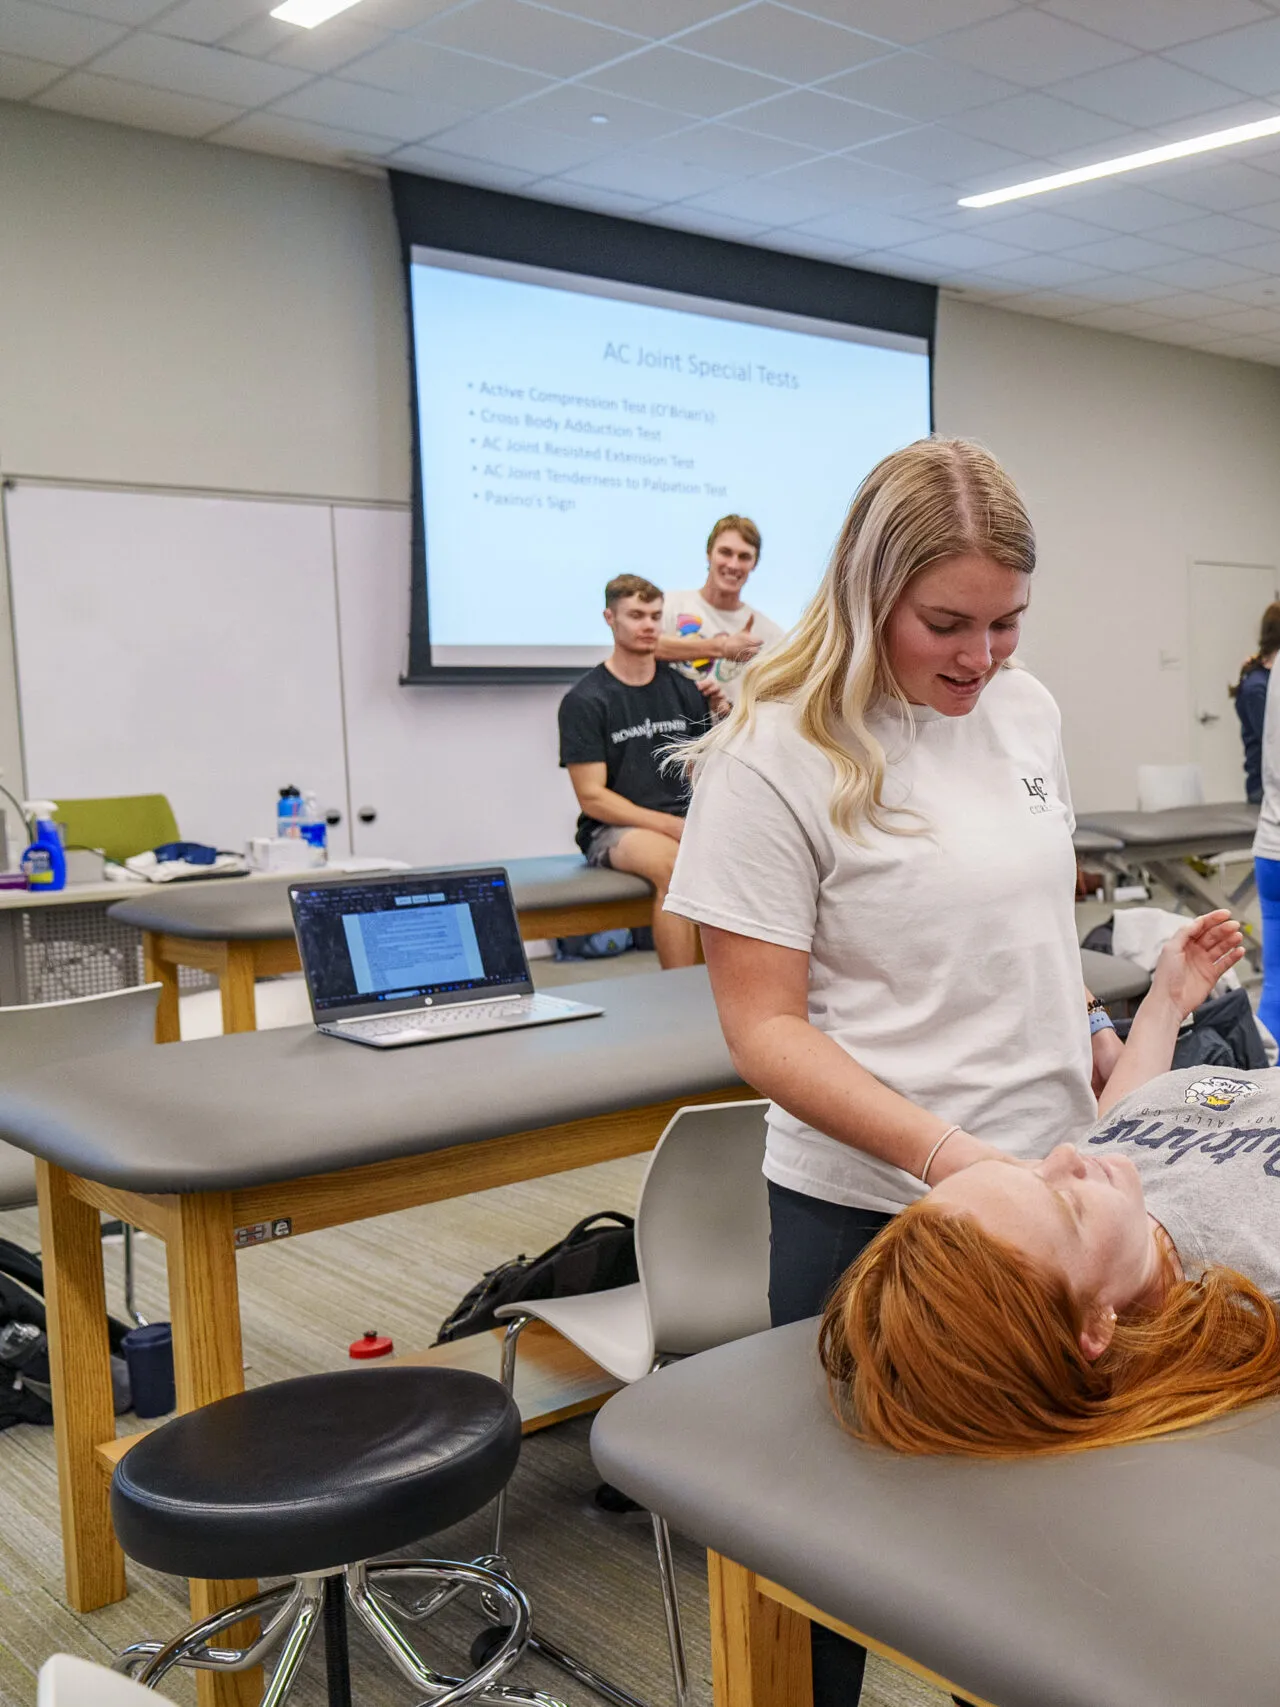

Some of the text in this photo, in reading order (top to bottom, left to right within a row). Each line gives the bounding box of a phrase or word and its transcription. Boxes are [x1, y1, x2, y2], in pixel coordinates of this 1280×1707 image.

[603, 341, 800, 390] AC Joint Special Tests
[480, 381, 524, 399] Active
[528, 386, 618, 411] Compression
[622, 398, 646, 415] Test
[481, 408, 662, 441] Cross Body Adduction Test
[482, 435, 695, 469] AC Joint Resisted Extension Test
[484, 463, 728, 497] AC Joint Tenderness to Palpation Test
